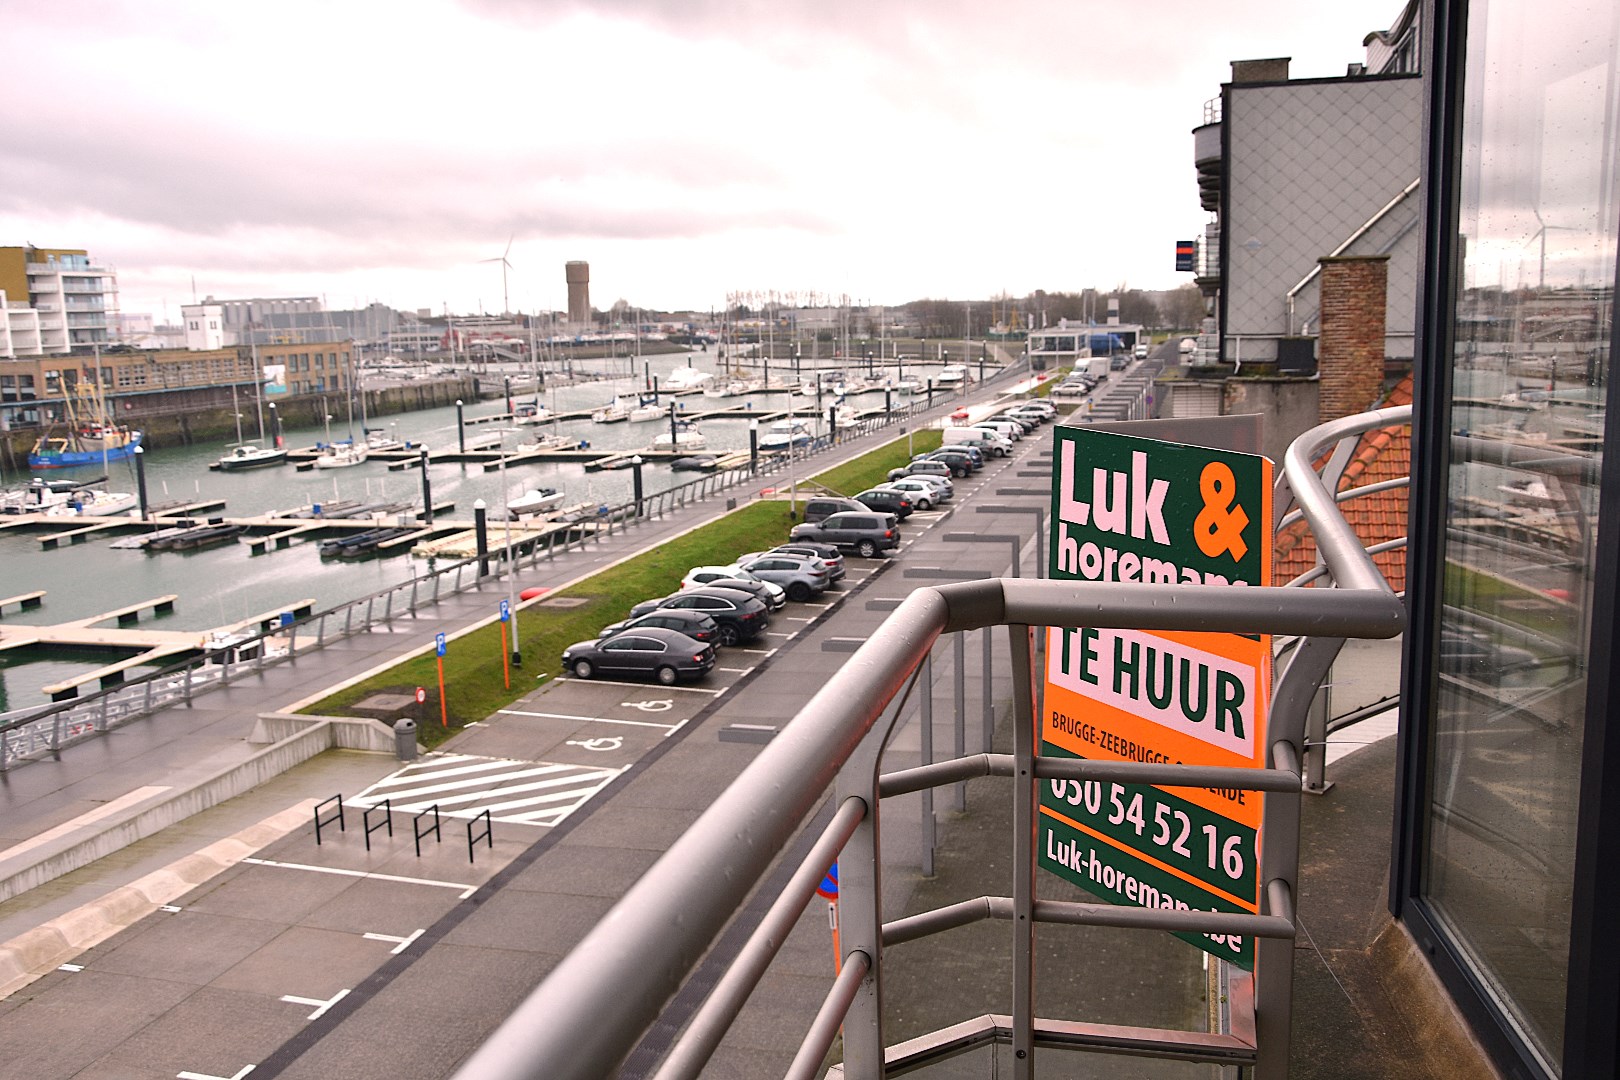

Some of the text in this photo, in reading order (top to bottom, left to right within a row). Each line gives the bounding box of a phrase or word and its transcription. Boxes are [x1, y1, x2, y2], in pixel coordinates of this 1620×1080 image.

[1059, 439, 1250, 563] Luk &
[1062, 627, 1246, 740] TE HUUR
[1108, 782, 1147, 836] 54
[1152, 801, 1191, 859] 52
[1202, 824, 1244, 880] 16
